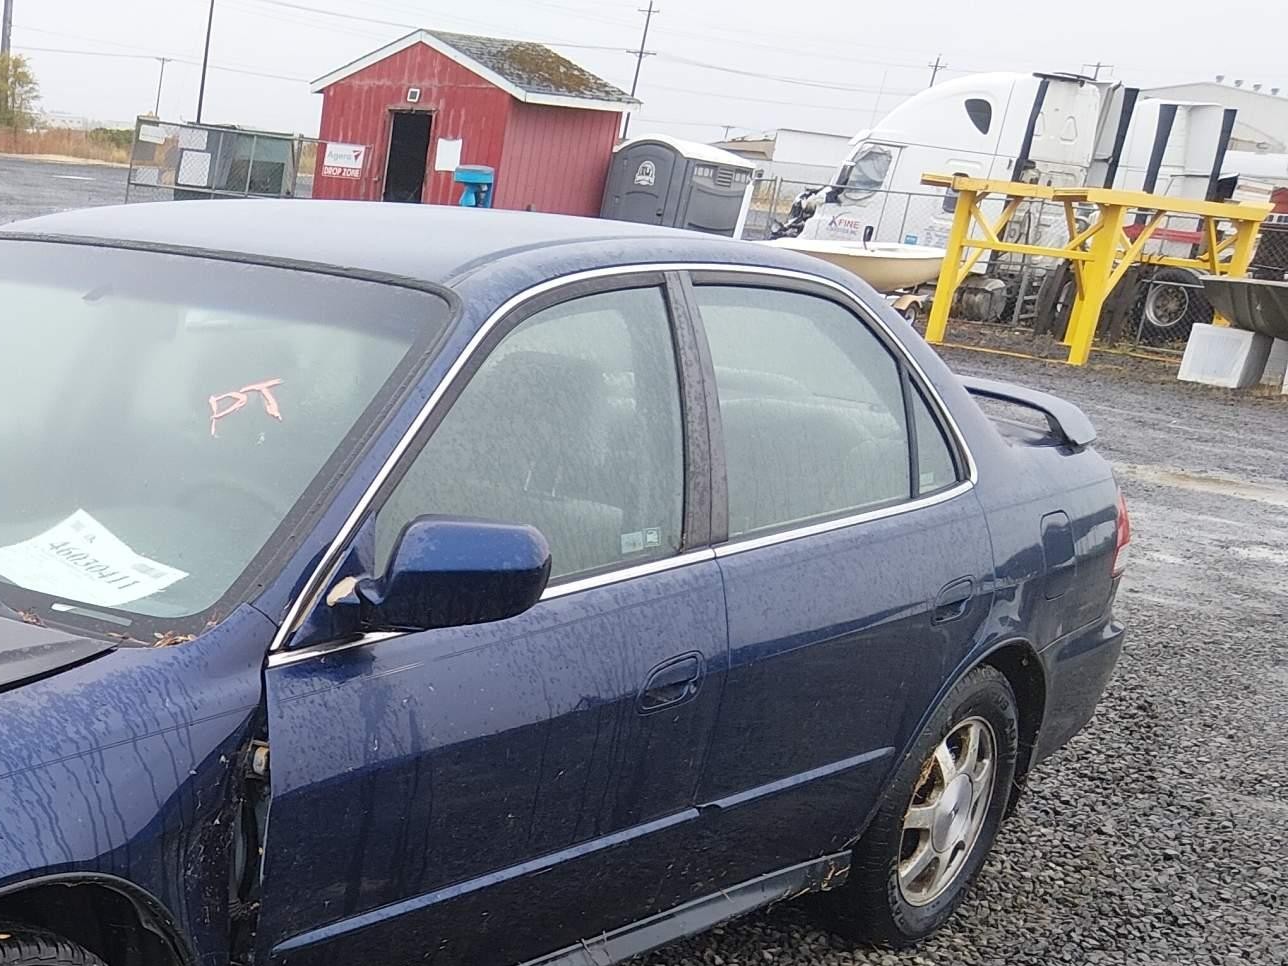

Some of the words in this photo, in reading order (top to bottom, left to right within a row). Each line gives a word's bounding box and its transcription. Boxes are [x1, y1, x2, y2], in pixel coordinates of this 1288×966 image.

[323, 166, 342, 177] DROP
[342, 168, 360, 178] ZONE
[49, 541, 141, 590] 46030411
